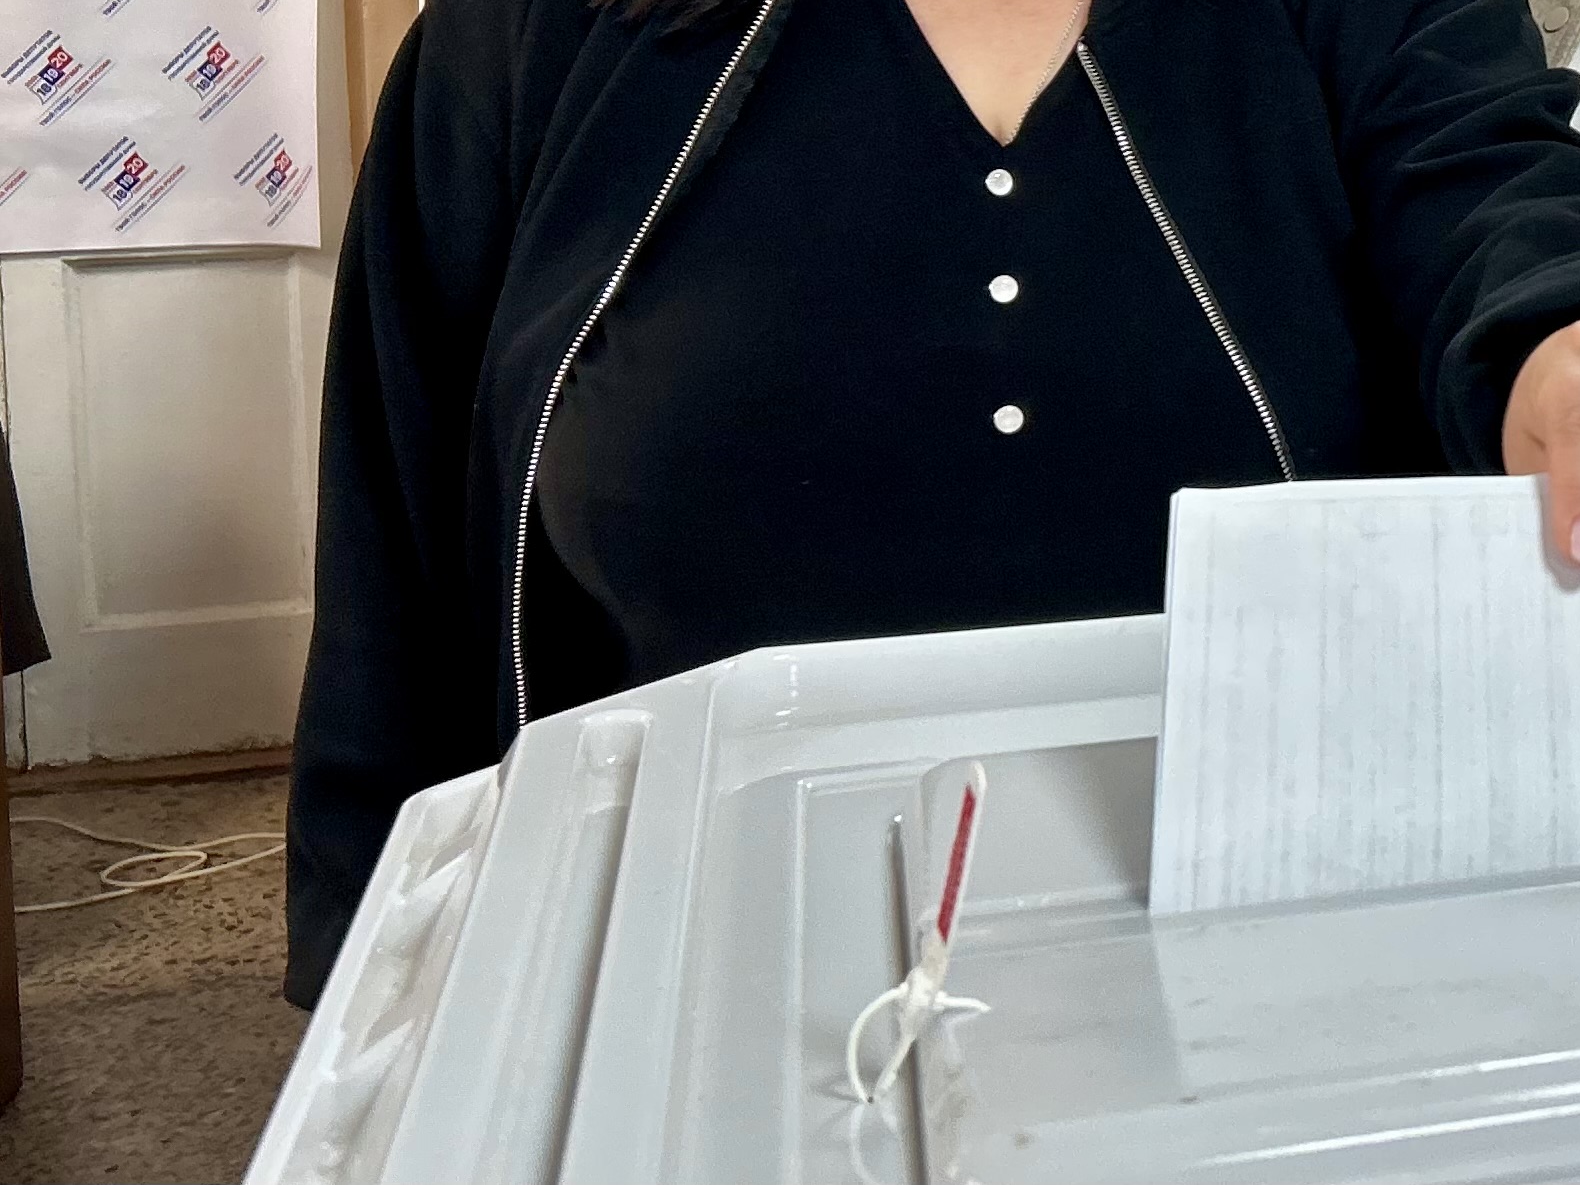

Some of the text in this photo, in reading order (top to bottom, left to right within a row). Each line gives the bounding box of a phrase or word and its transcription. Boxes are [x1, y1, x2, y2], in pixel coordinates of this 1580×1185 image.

[36, 50, 68, 97] 18 19 20
[196, 46, 225, 93] 18 19 20
[112, 156, 143, 203] 18 19 20
